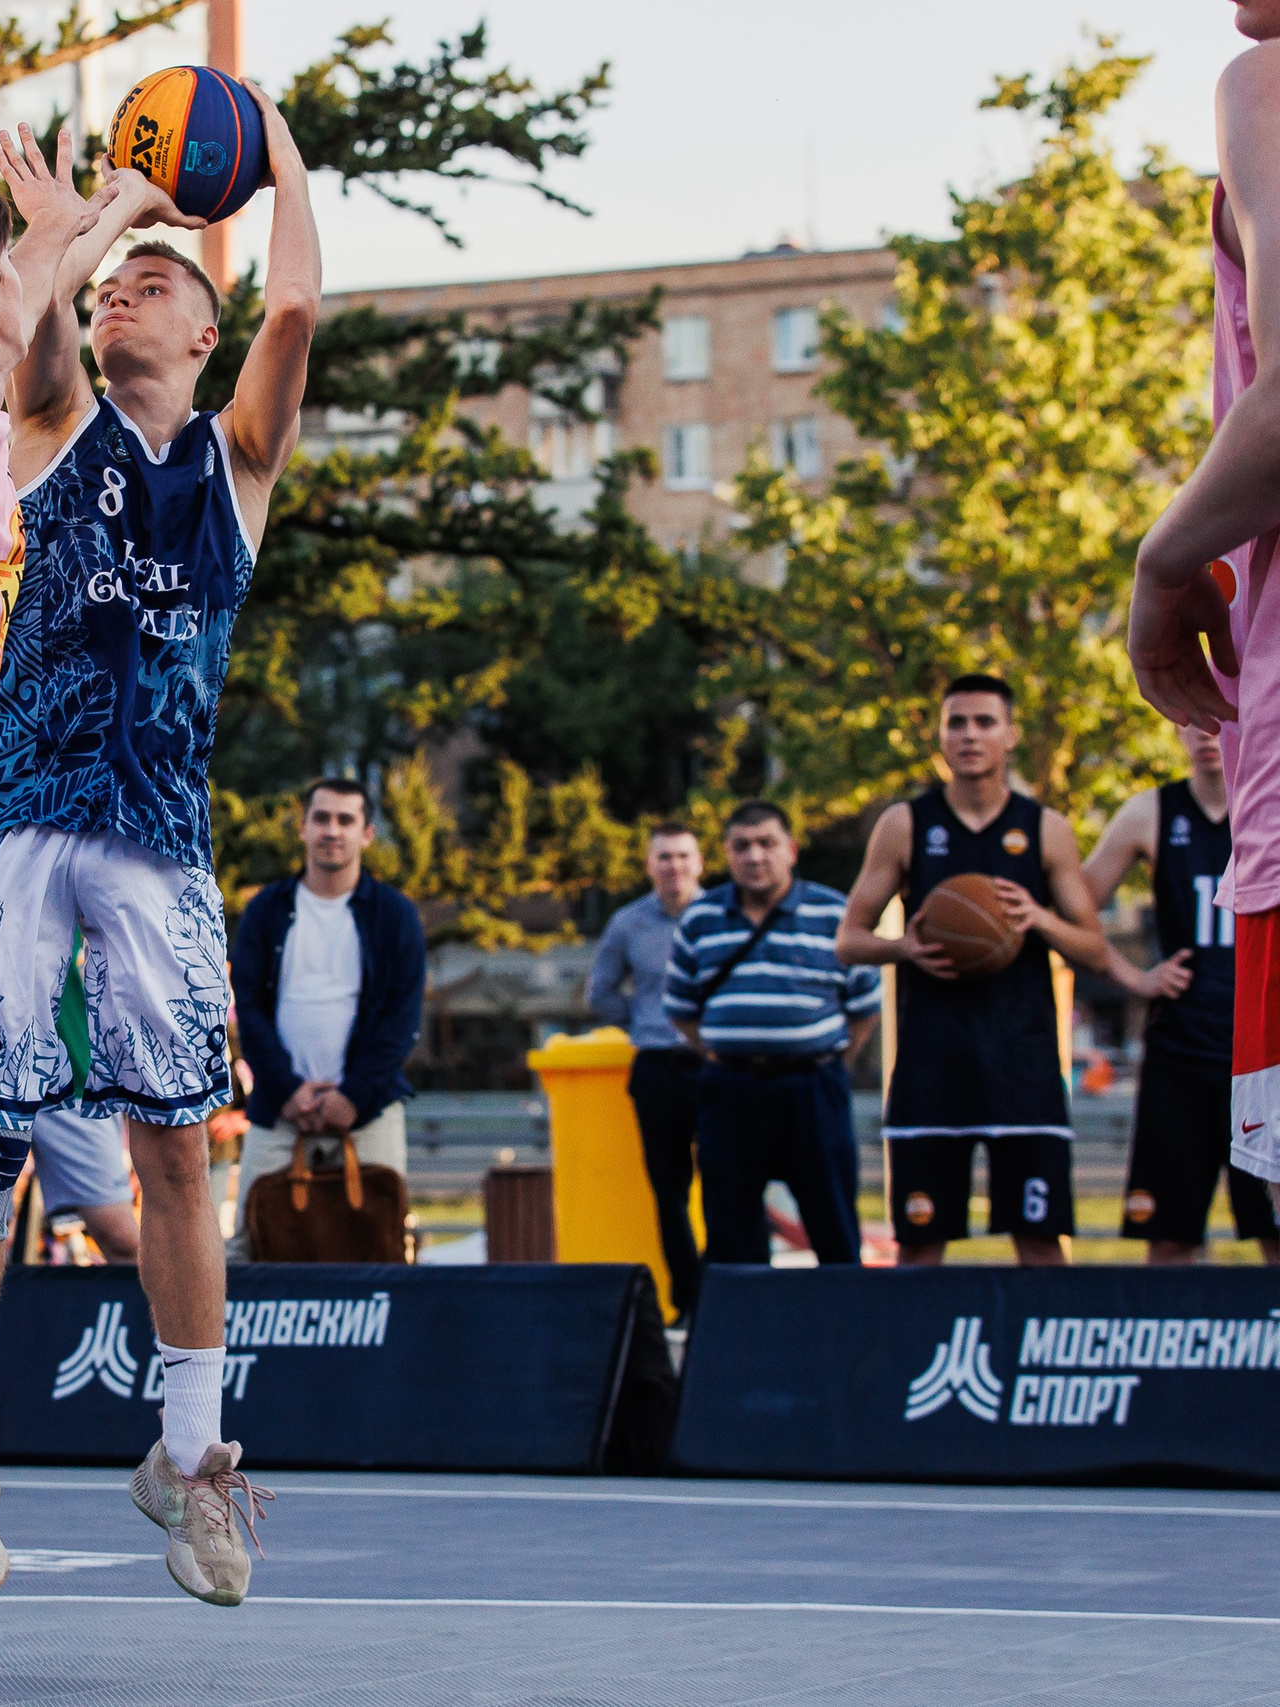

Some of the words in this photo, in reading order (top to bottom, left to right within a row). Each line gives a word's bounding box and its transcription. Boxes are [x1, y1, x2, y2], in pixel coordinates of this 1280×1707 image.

[154, 151, 162, 168] FIBA
[165, 129, 174, 146] BALL
[161, 147, 170, 179] OFFICIAL
[98, 467, 126, 516] 8
[1023, 1177, 1049, 1223] 6
[223, 1291, 392, 1346] КОВСКИЙ
[142, 1353, 258, 1400] СРТ
[1009, 1375, 1142, 1425] СПОРТ
